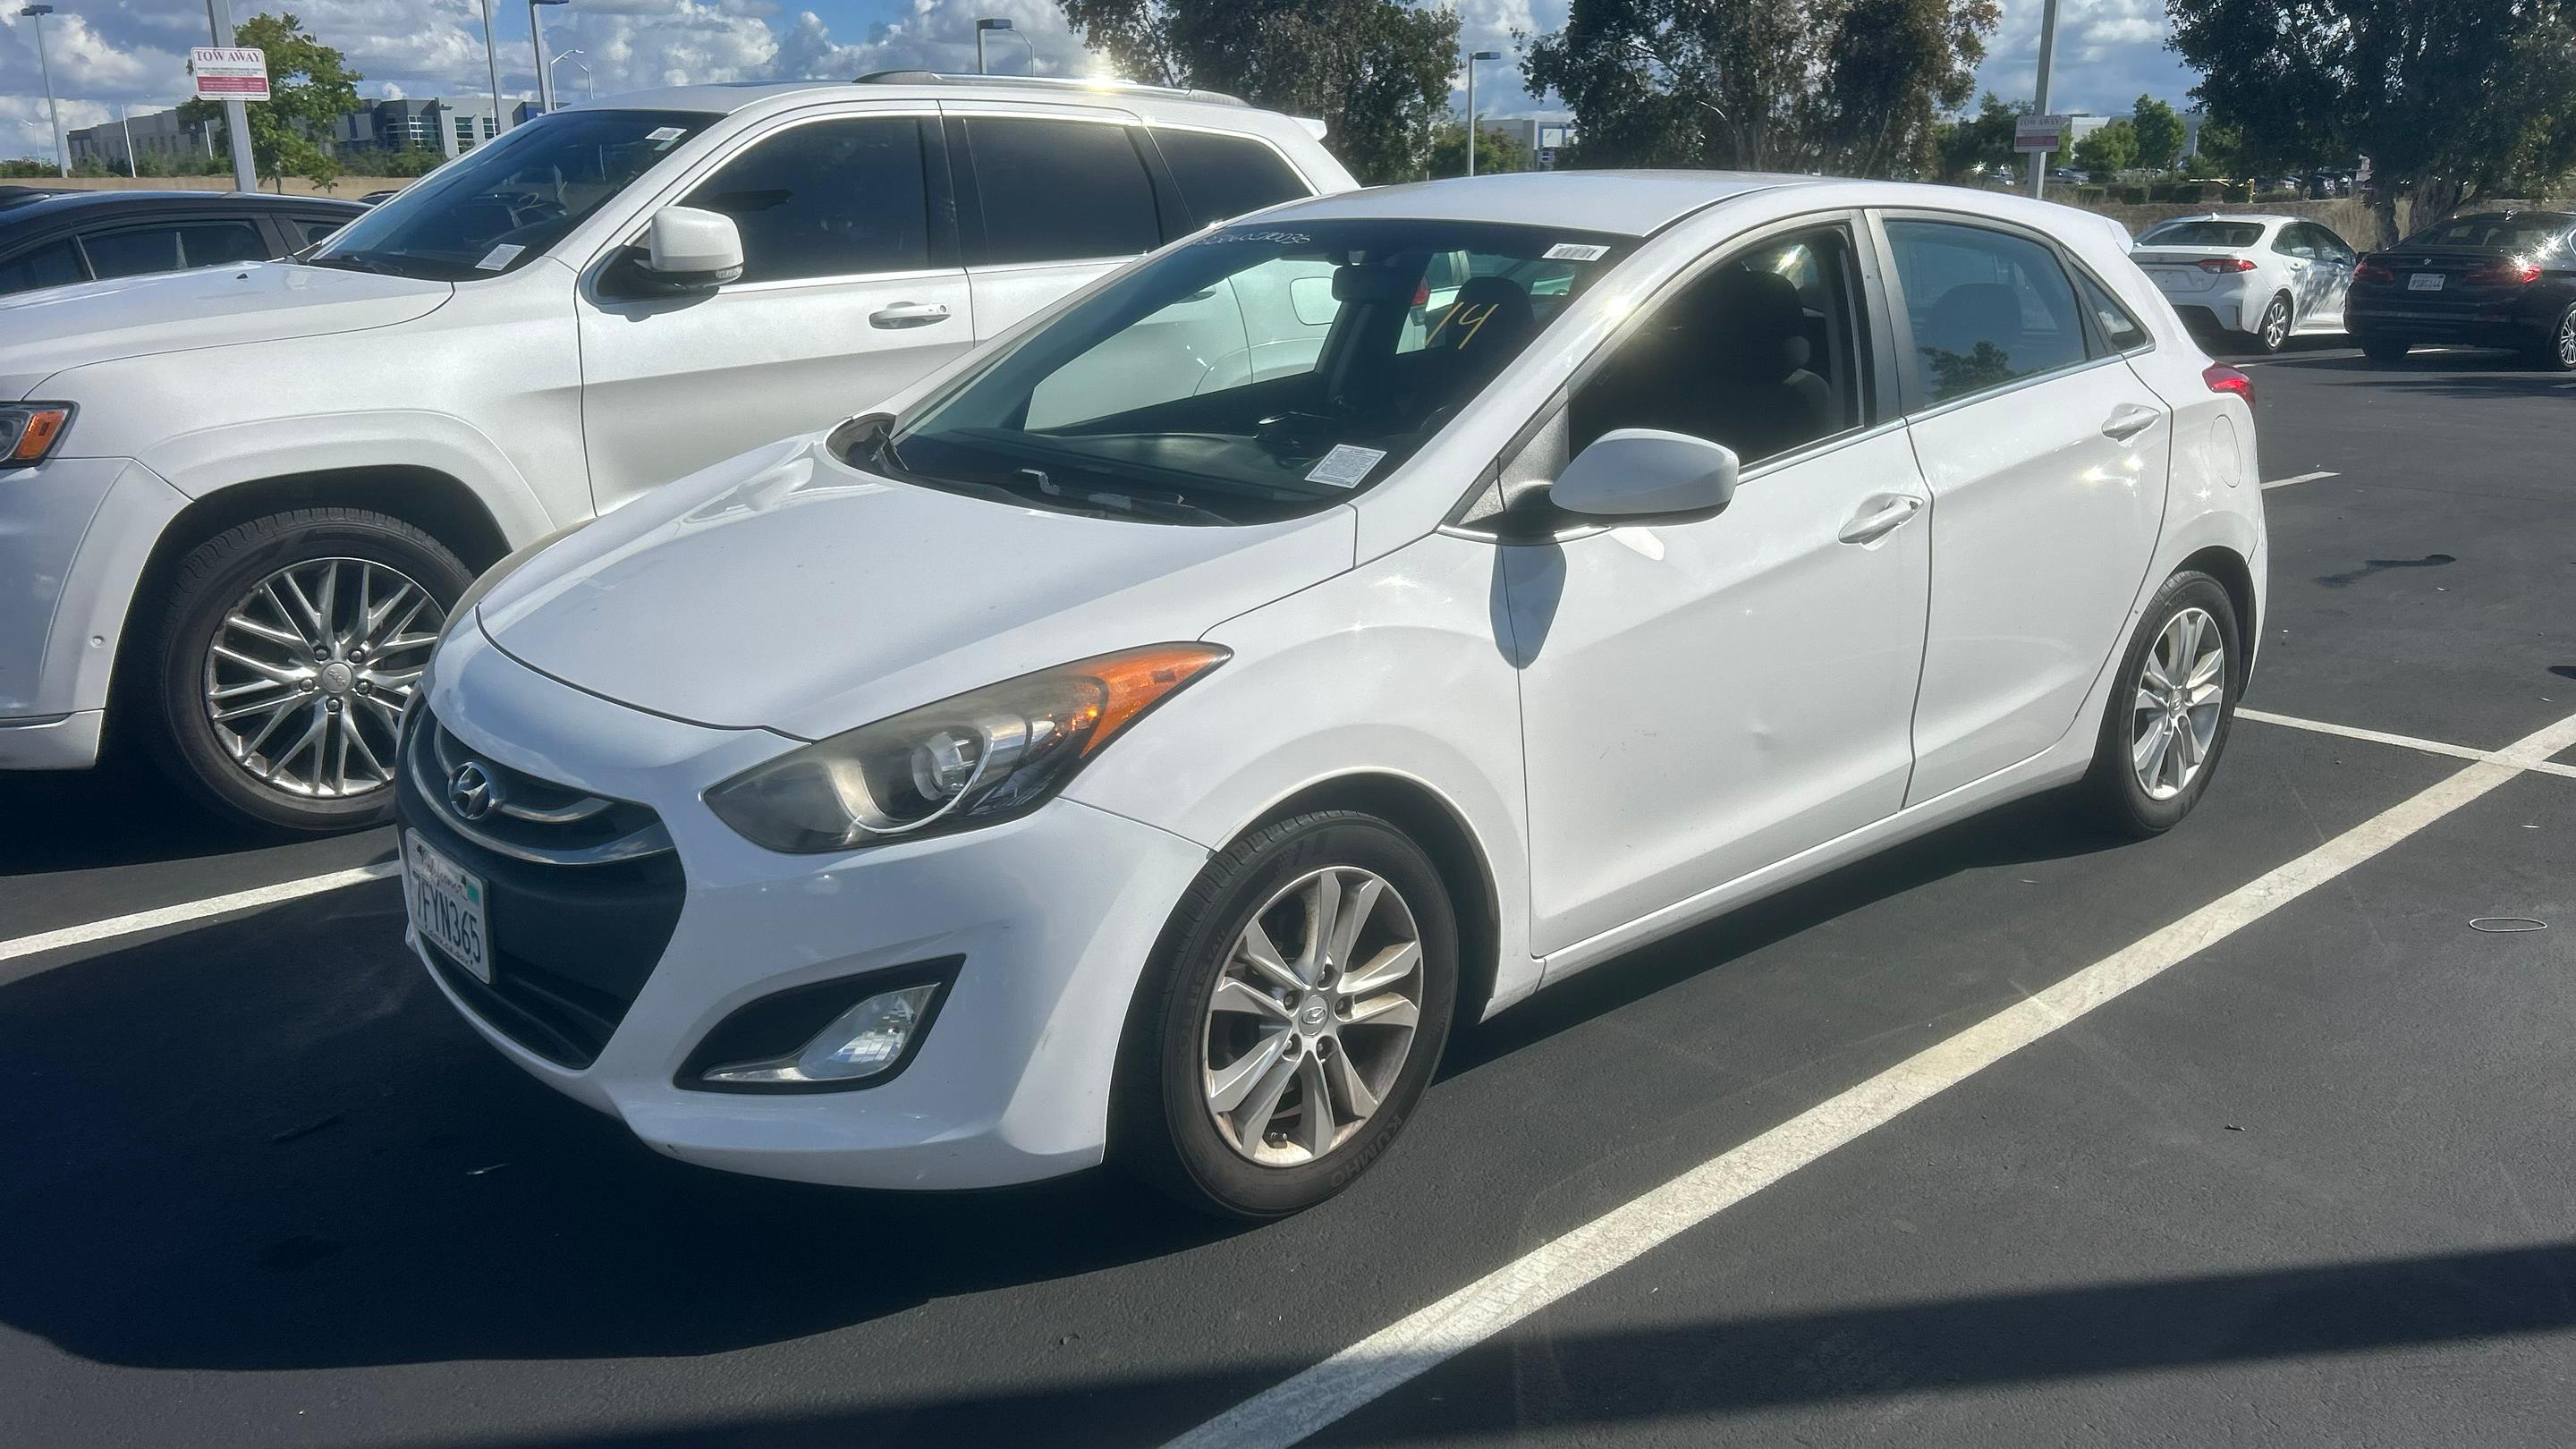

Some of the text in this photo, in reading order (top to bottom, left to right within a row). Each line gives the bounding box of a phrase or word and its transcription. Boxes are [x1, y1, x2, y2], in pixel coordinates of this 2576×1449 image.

[195, 51, 261, 63] TOW AWAY
[1425, 301, 1500, 350] 14
[412, 869, 481, 964] 7FYN365
[1330, 1114, 1403, 1189] KUMHO
